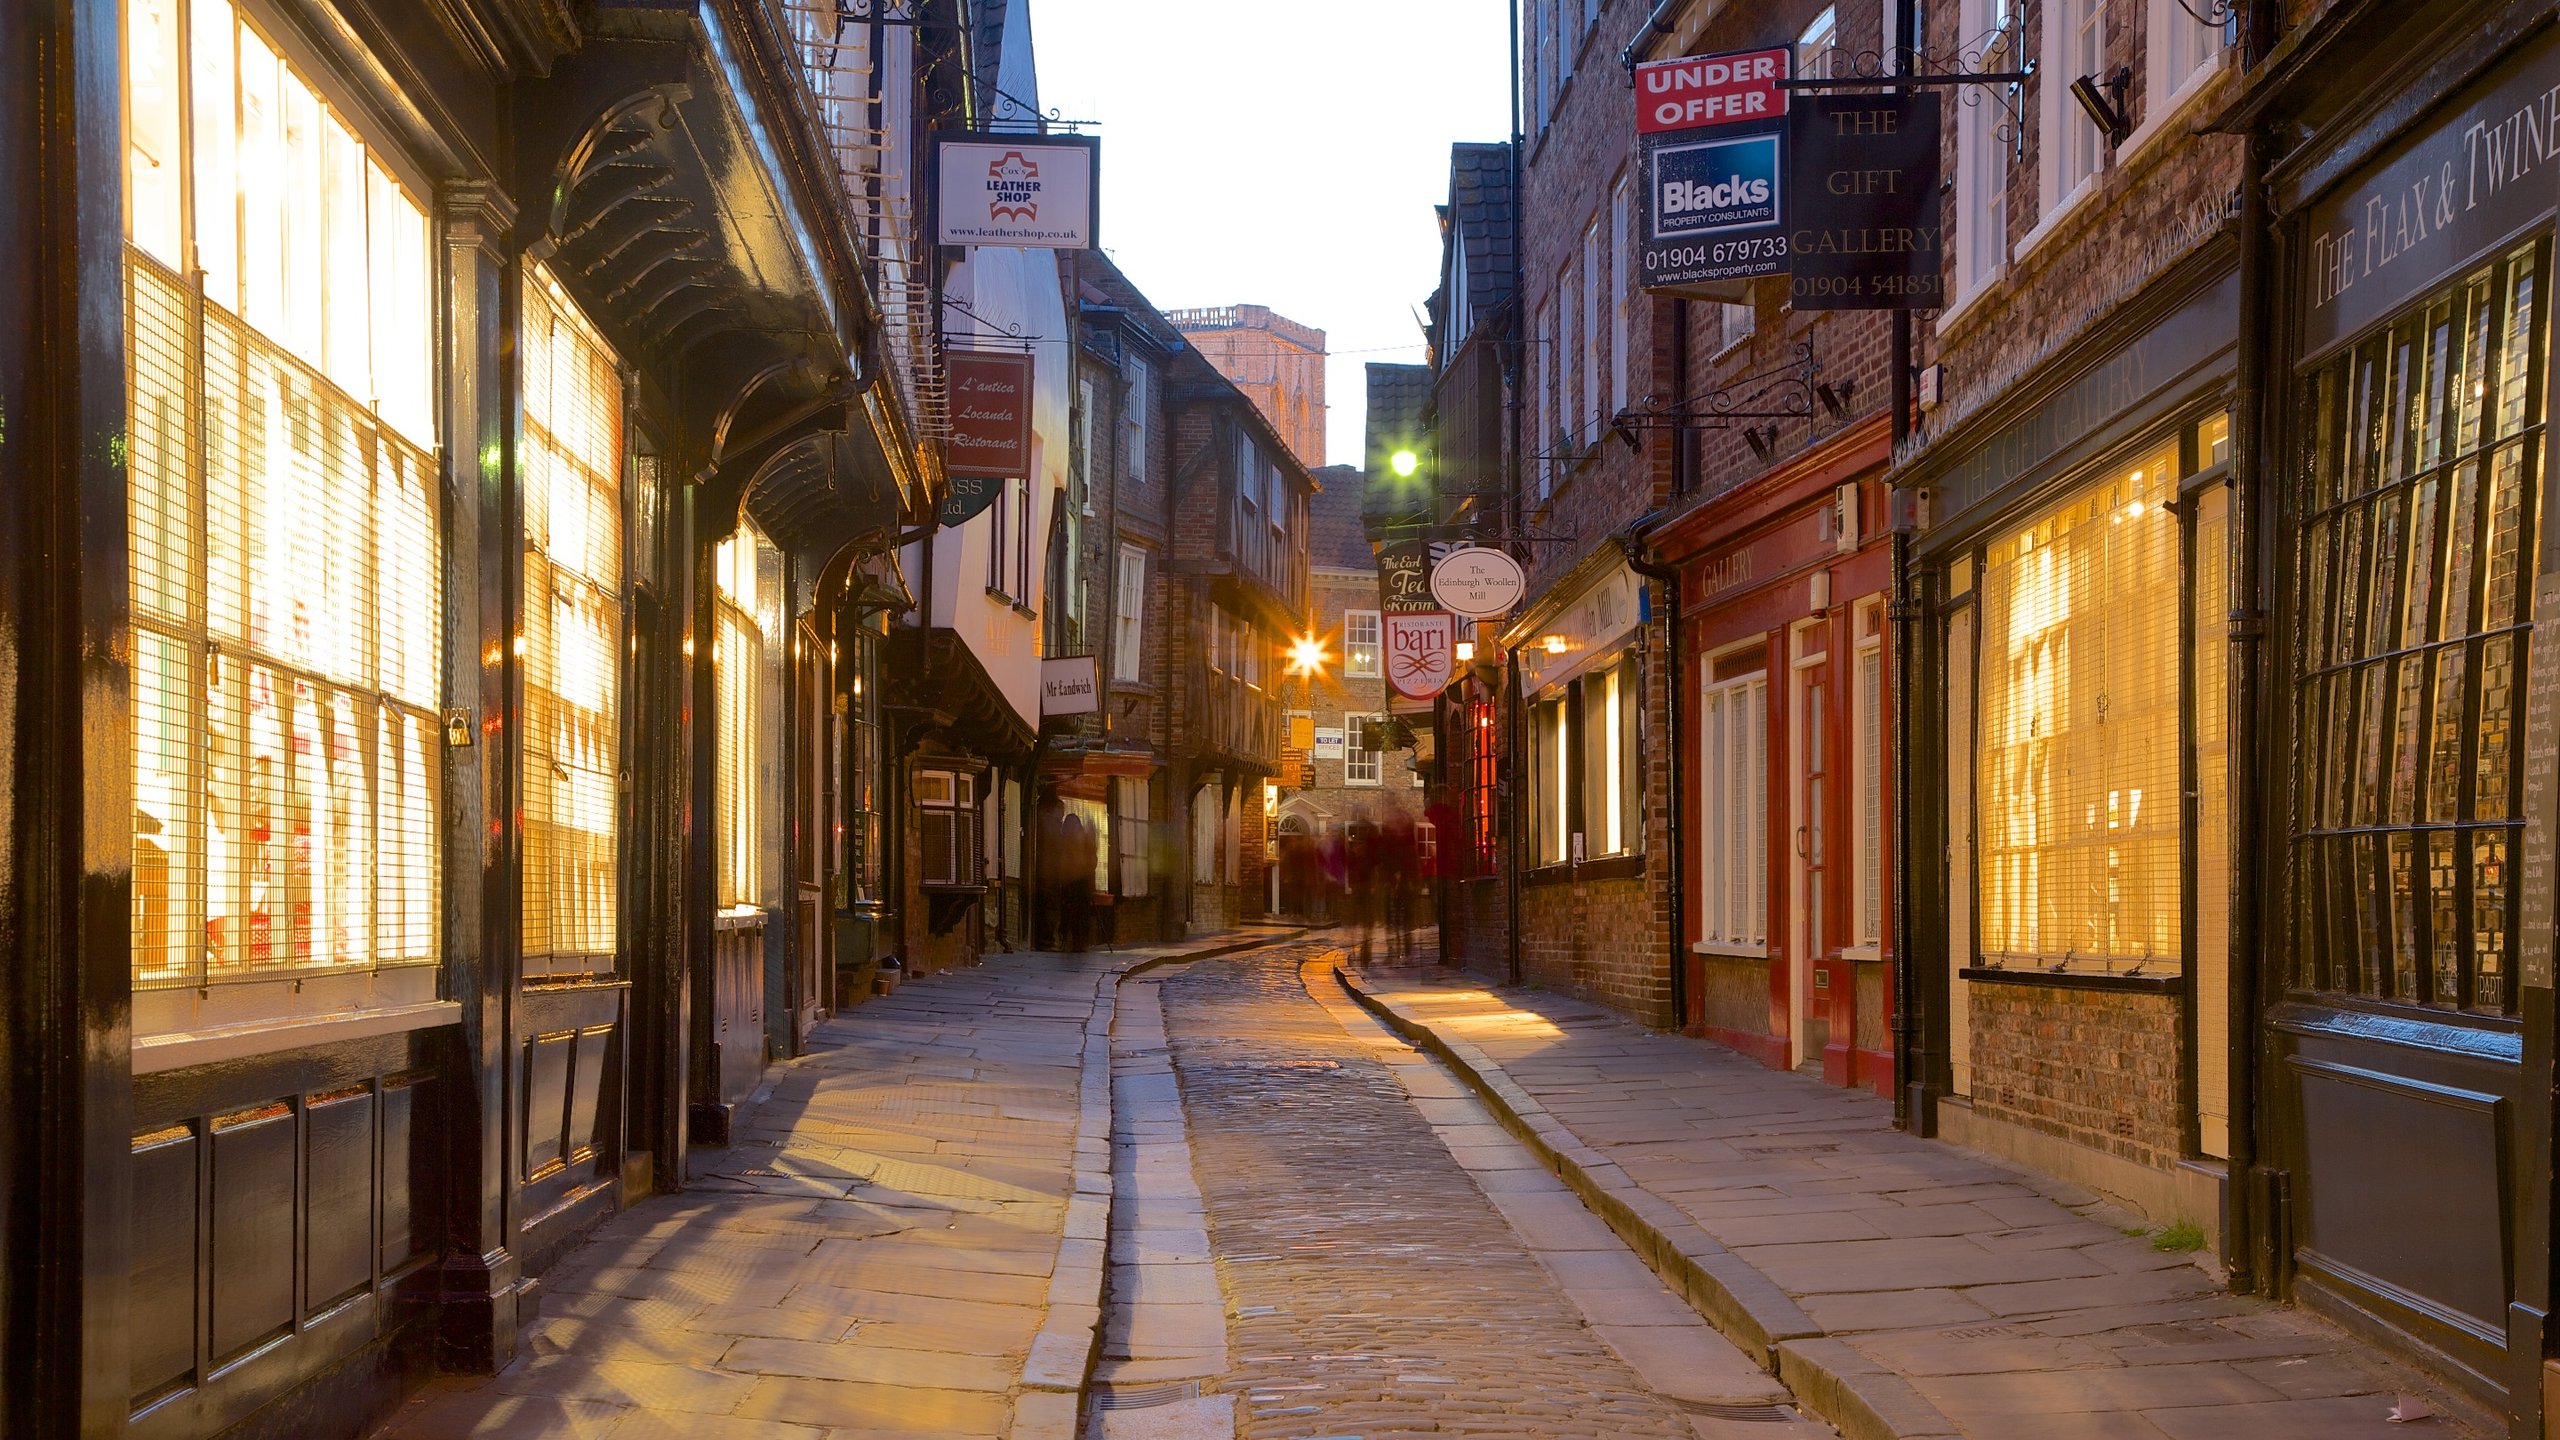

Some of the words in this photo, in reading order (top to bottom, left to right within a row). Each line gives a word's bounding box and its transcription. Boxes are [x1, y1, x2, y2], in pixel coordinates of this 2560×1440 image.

[1647, 56, 1775, 94] UNDER
[1655, 93, 1767, 125] OFFER
[1830, 110, 1897, 136] THE
[1000, 166, 1026, 176] Cox's
[986, 180, 1041, 192] LEATHER
[1826, 169, 1902, 195] GIFT
[996, 192, 1032, 203] SHOP
[1663, 174, 1770, 214] Blacks
[2314, 227, 2356, 309] THE
[2363, 174, 2430, 278] FLAX
[2435, 160, 2456, 231] &
[2464, 84, 2560, 212] TWINE
[1663, 214, 1708, 228] PROPERTY
[1708, 207, 1770, 224] CONSULTANTS
[950, 228, 1078, 240] www.leathershop.co.uk
[1792, 227, 1939, 255] GALLERY
[1646, 246, 1706, 270] 01904
[1713, 236, 1787, 263] 679733
[1657, 261, 1777, 282] www.blacksproperty.com
[1792, 276, 1863, 297] 01904
[1871, 274, 1941, 296] 541851
[958, 405, 1014, 421] Locanda
[1961, 446, 1993, 507] THE
[2002, 411, 2043, 480] GIFT
[2054, 335, 2149, 448] GALLERY
[953, 433, 1018, 450] Ristorante
[1382, 554, 1400, 570] The
[1400, 554, 1422, 568] Earl
[1470, 566, 1486, 575] The
[1702, 546, 1755, 598] GALLERY
[1438, 577, 1480, 588] Edinburgh
[1484, 577, 1517, 587] Woollen
[1469, 591, 1486, 600] Mill
[1392, 622, 1447, 651] bari
[1046, 681, 1057, 697] Mr
